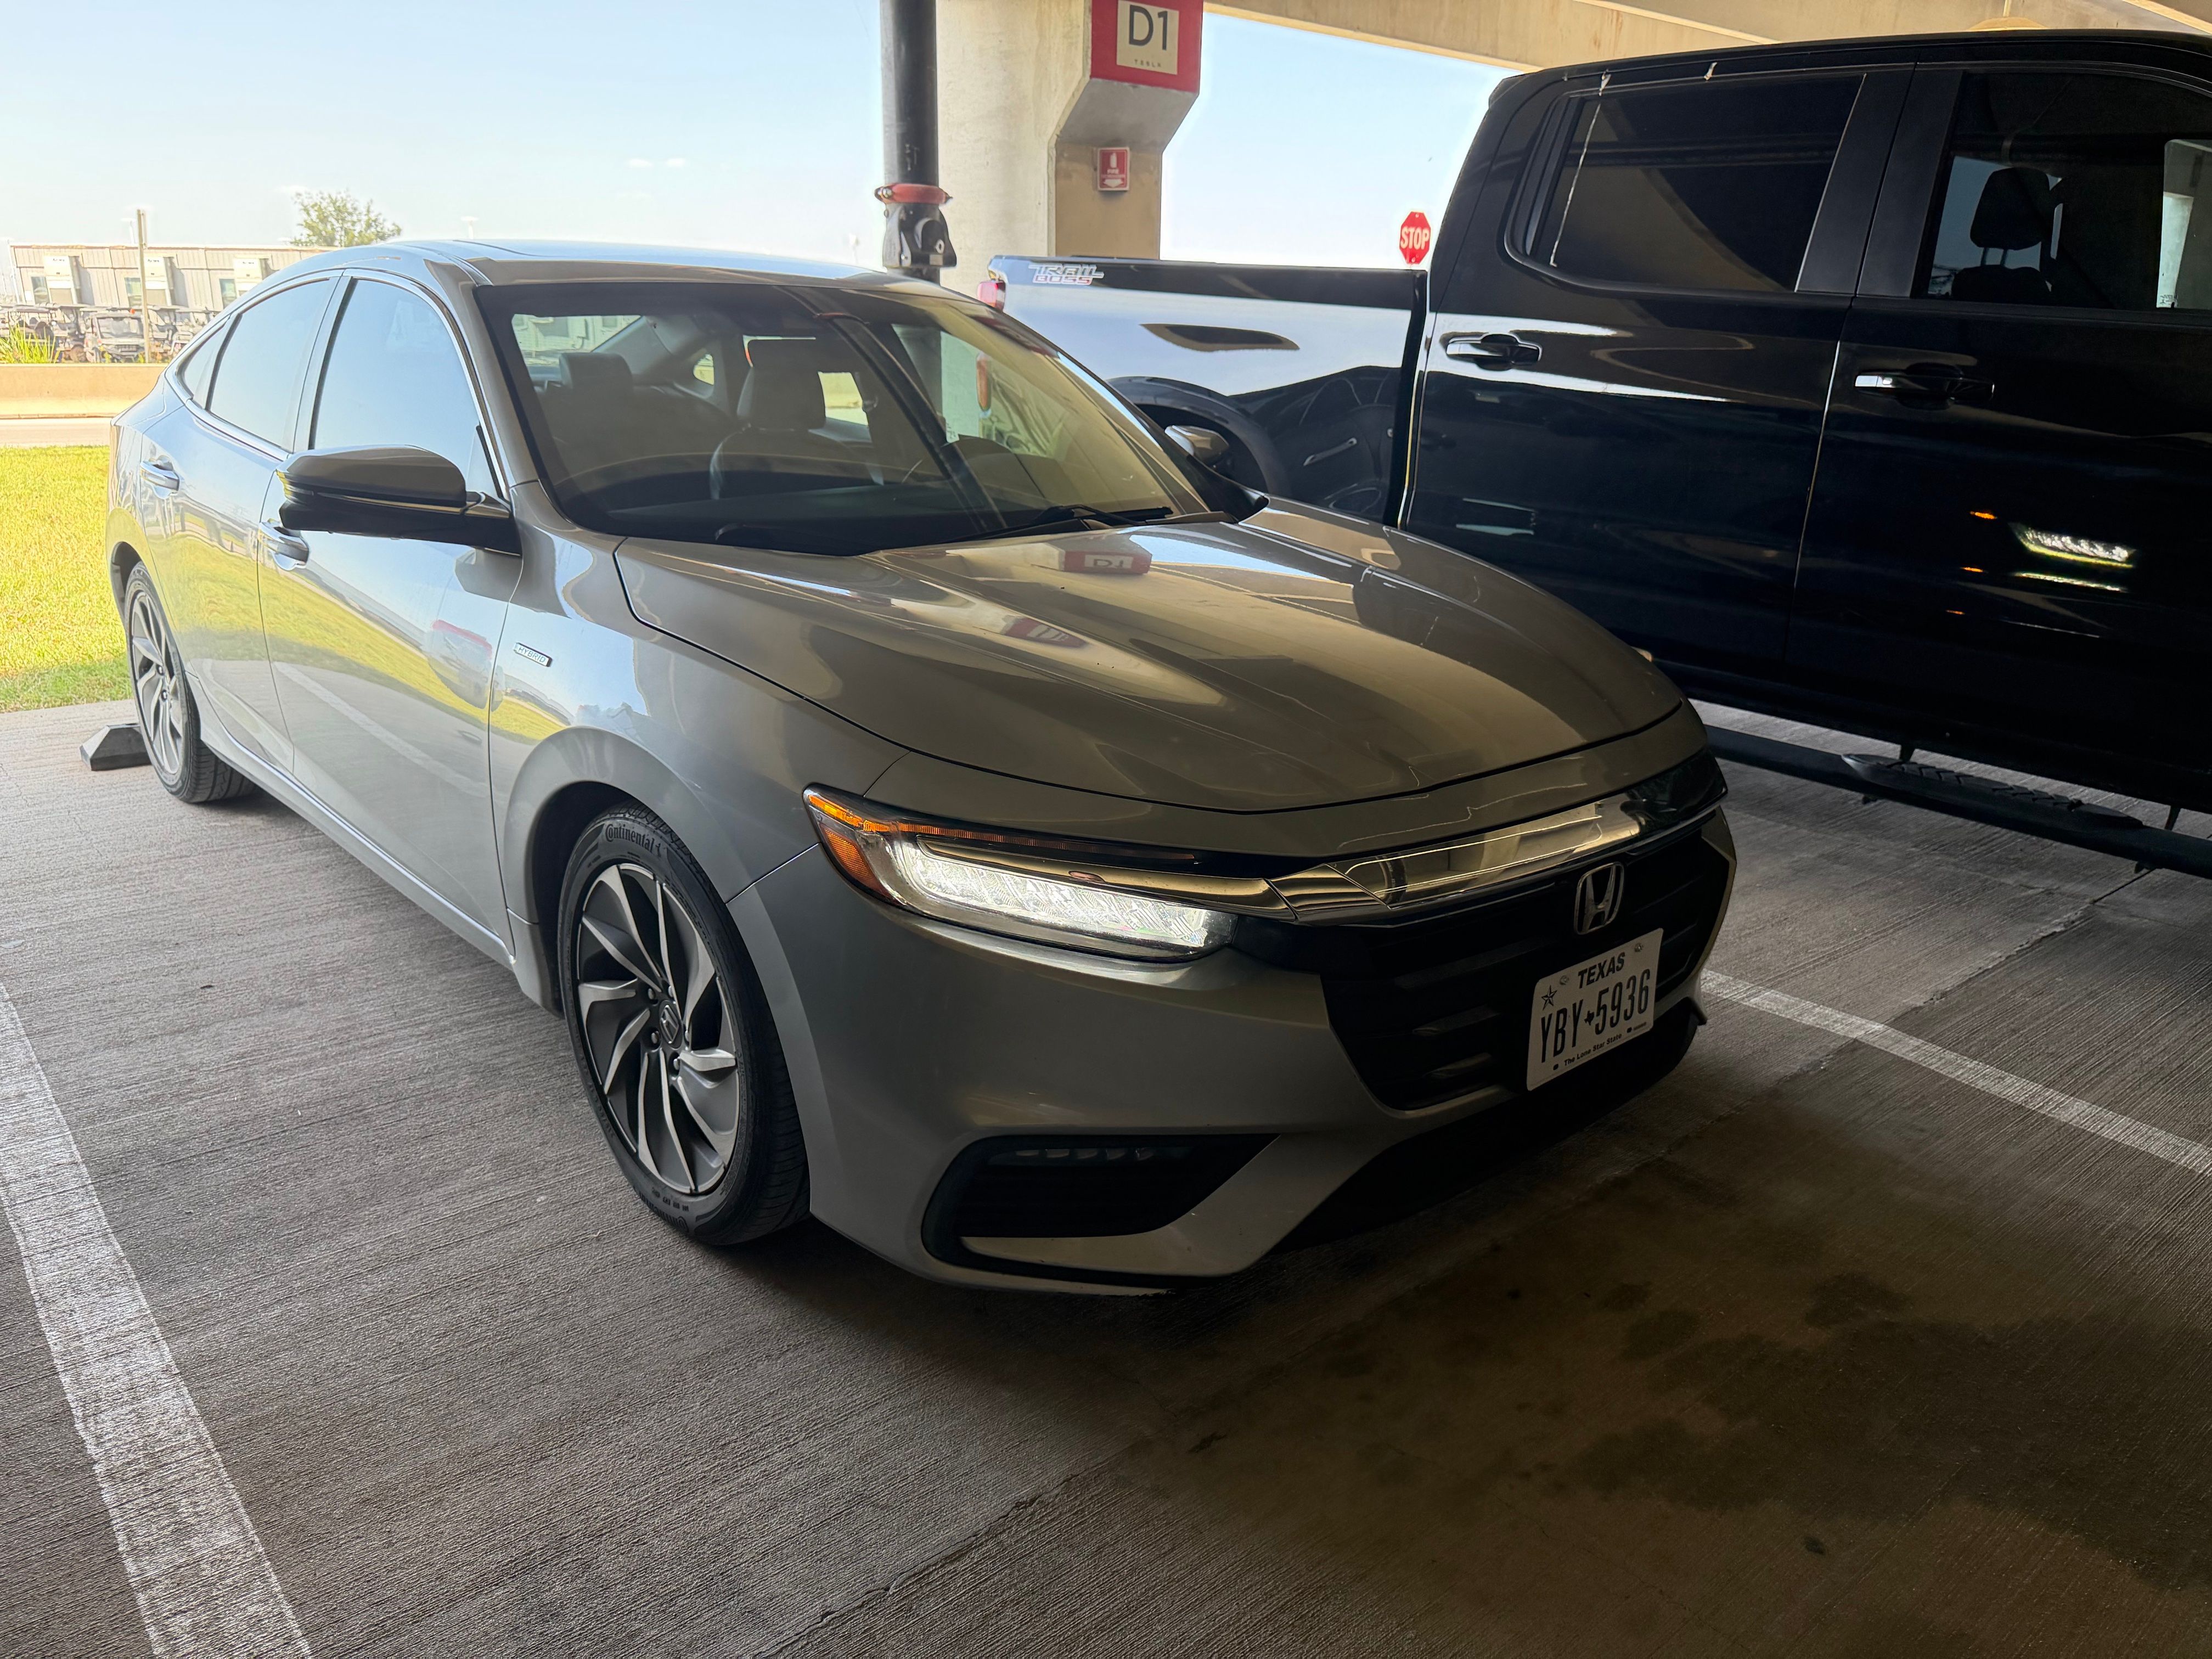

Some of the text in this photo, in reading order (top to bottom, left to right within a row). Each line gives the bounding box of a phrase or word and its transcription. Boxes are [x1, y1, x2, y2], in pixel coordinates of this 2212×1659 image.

[1128, 4, 1168, 50] D1
[1134, 59, 1162, 68] TESLA
[1400, 225, 1430, 250] STOP
[1028, 263, 1104, 278] TRAIL
[1032, 274, 1093, 285] BOSS
[518, 646, 546, 662] HYBRID
[605, 823, 655, 854] Continental
[1577, 952, 1625, 989] TEXAS
[1564, 1033, 1622, 1066] The Lone Star State
